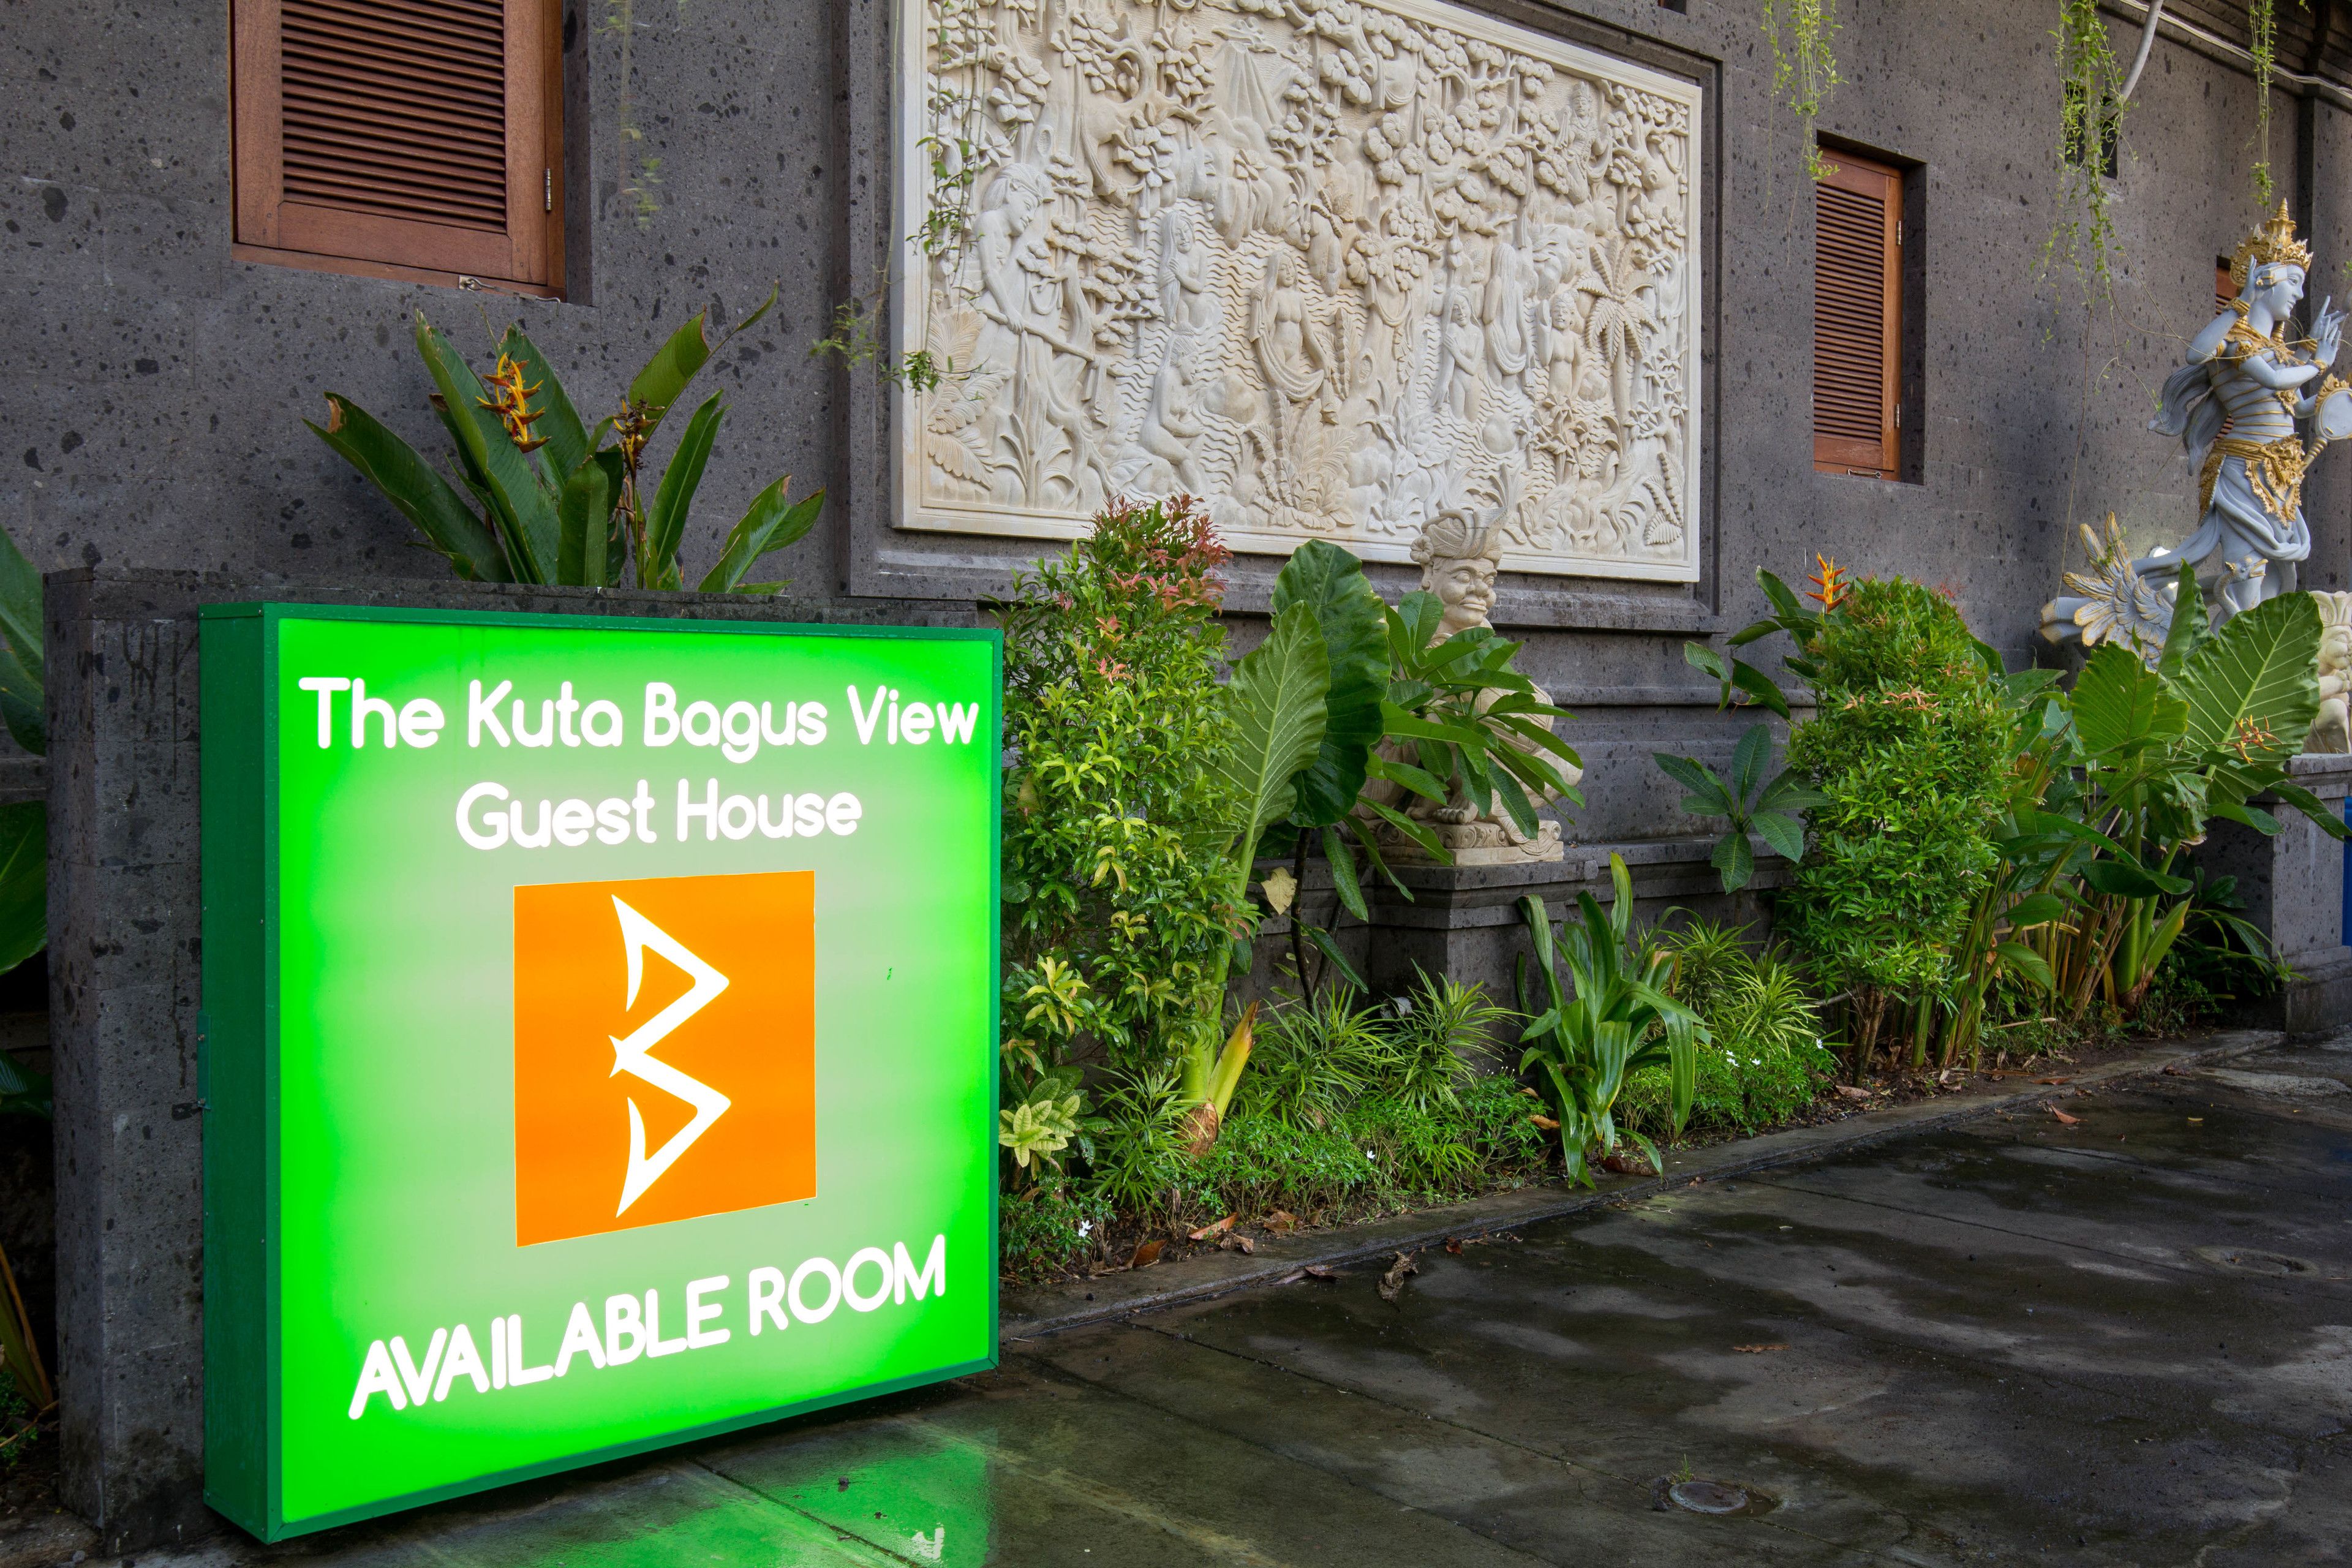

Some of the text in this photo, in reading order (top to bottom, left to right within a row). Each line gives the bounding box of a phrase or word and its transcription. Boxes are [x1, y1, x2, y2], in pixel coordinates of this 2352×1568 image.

[298, 676, 979, 764] The Kuta Bagus View
[455, 777, 863, 851] Guest House
[348, 1234, 946, 1420] AVAILABLE ROOM
